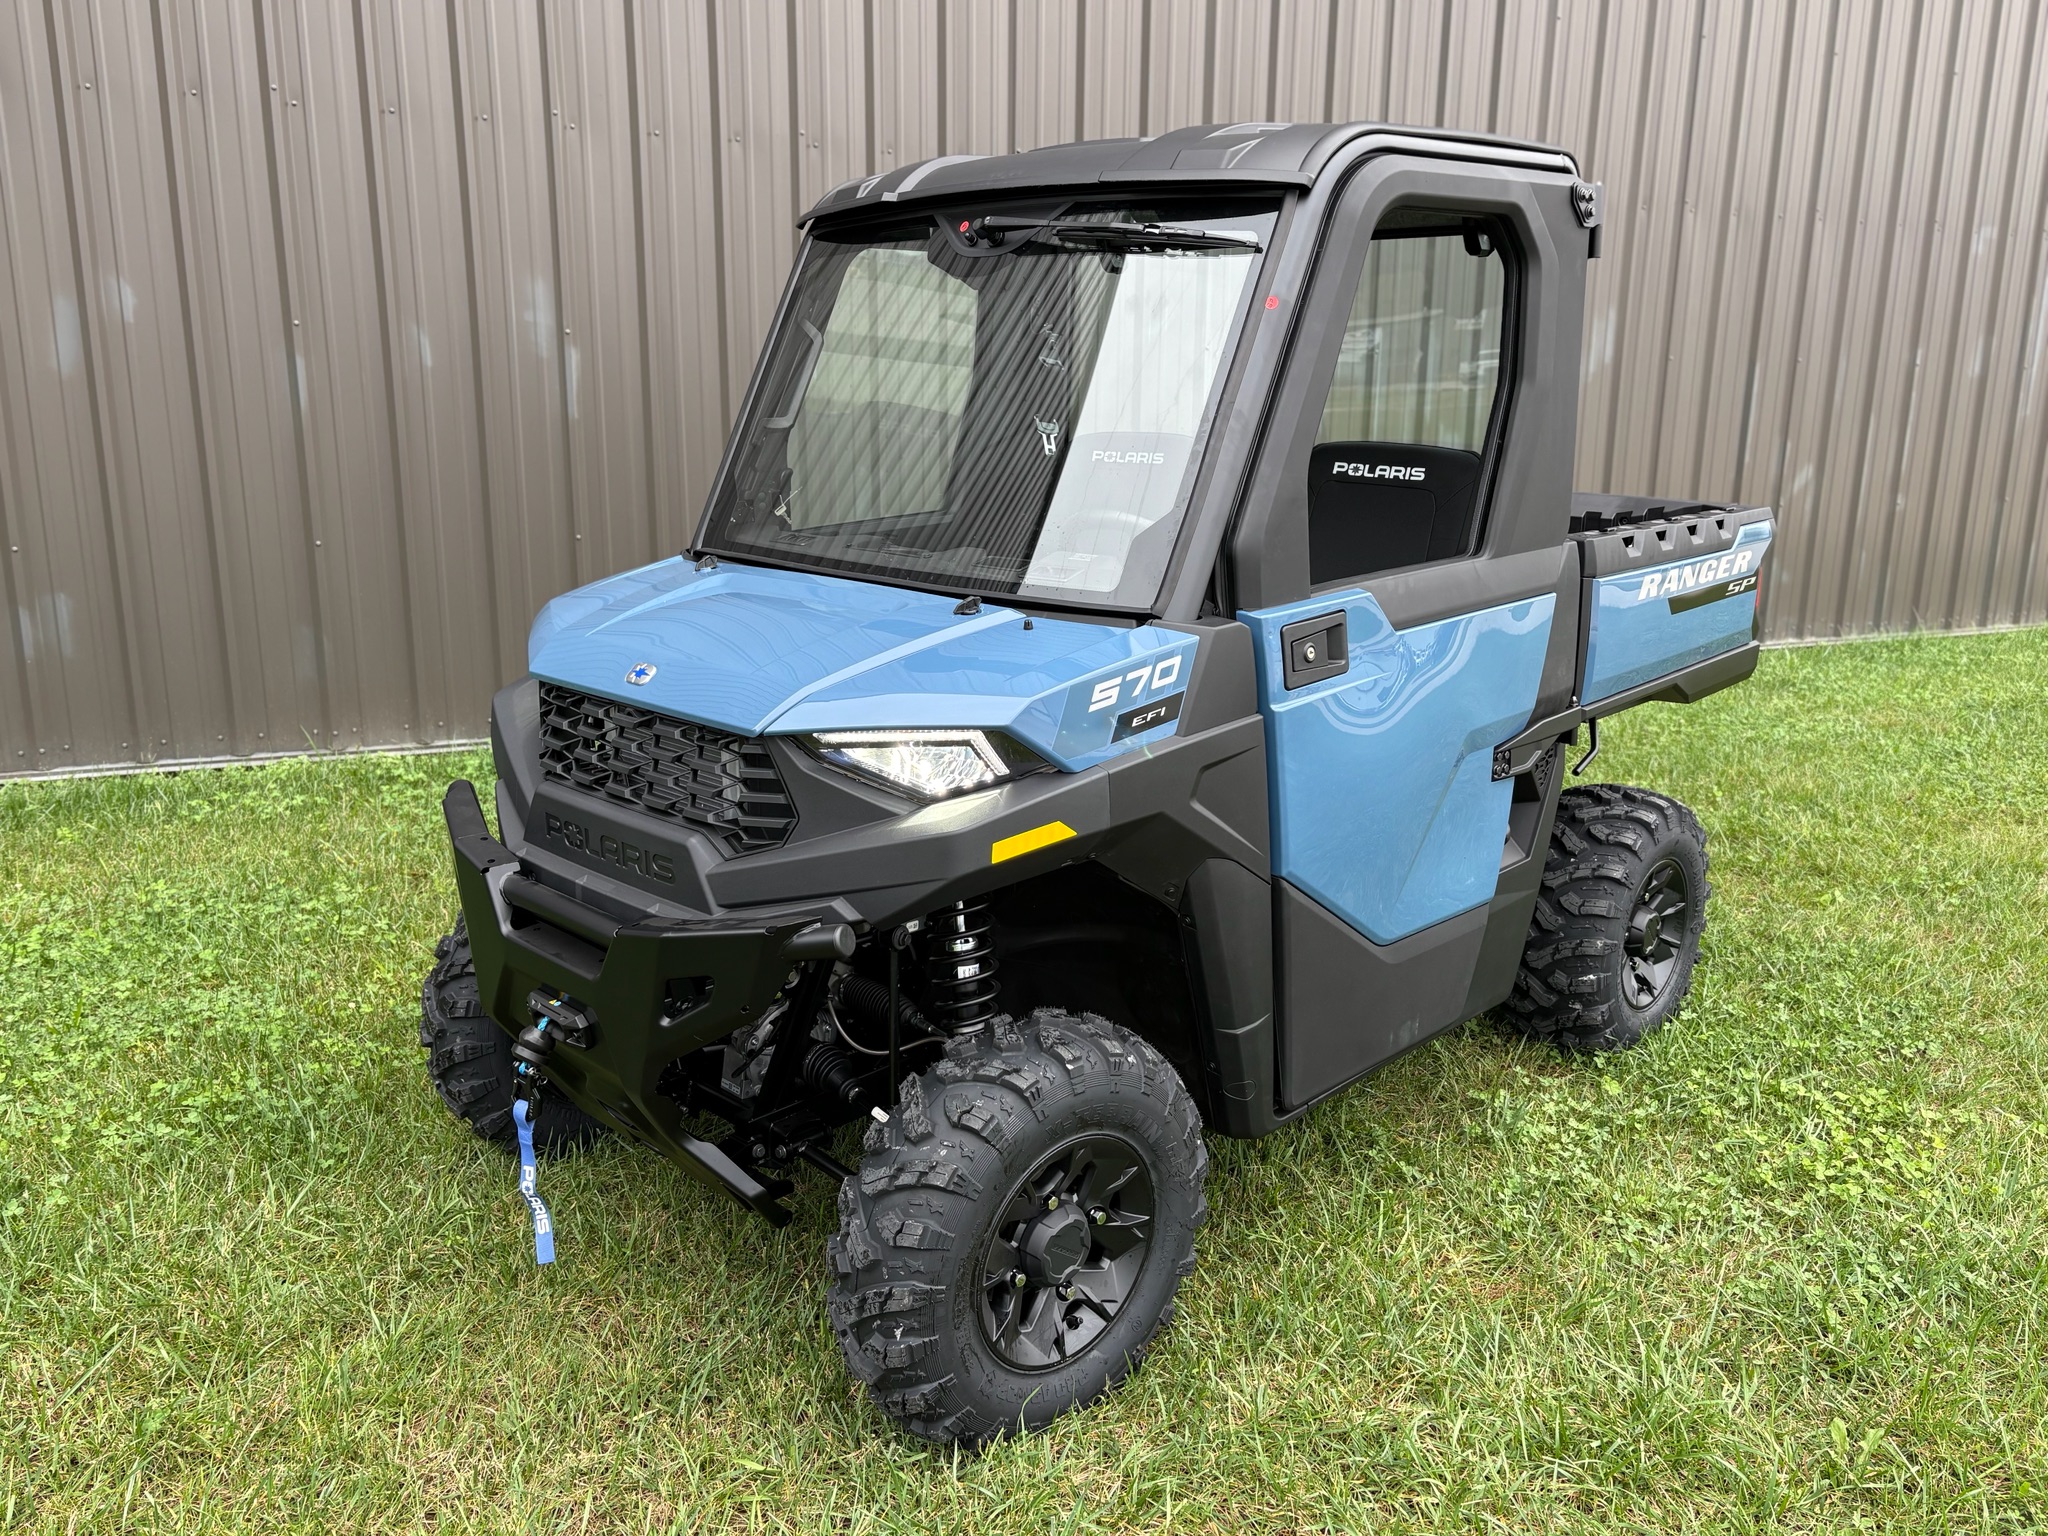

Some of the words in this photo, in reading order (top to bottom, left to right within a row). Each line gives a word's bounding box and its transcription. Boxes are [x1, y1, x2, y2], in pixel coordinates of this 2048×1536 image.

[1091, 450, 1165, 464] POLARIS
[1332, 461, 1426, 481] POLARIS
[1638, 550, 1753, 601] RANGER
[1725, 576, 1757, 596] SP
[1088, 655, 1182, 713] 570
[1131, 706, 1166, 728] EFI
[545, 812, 677, 887] POLARIS
